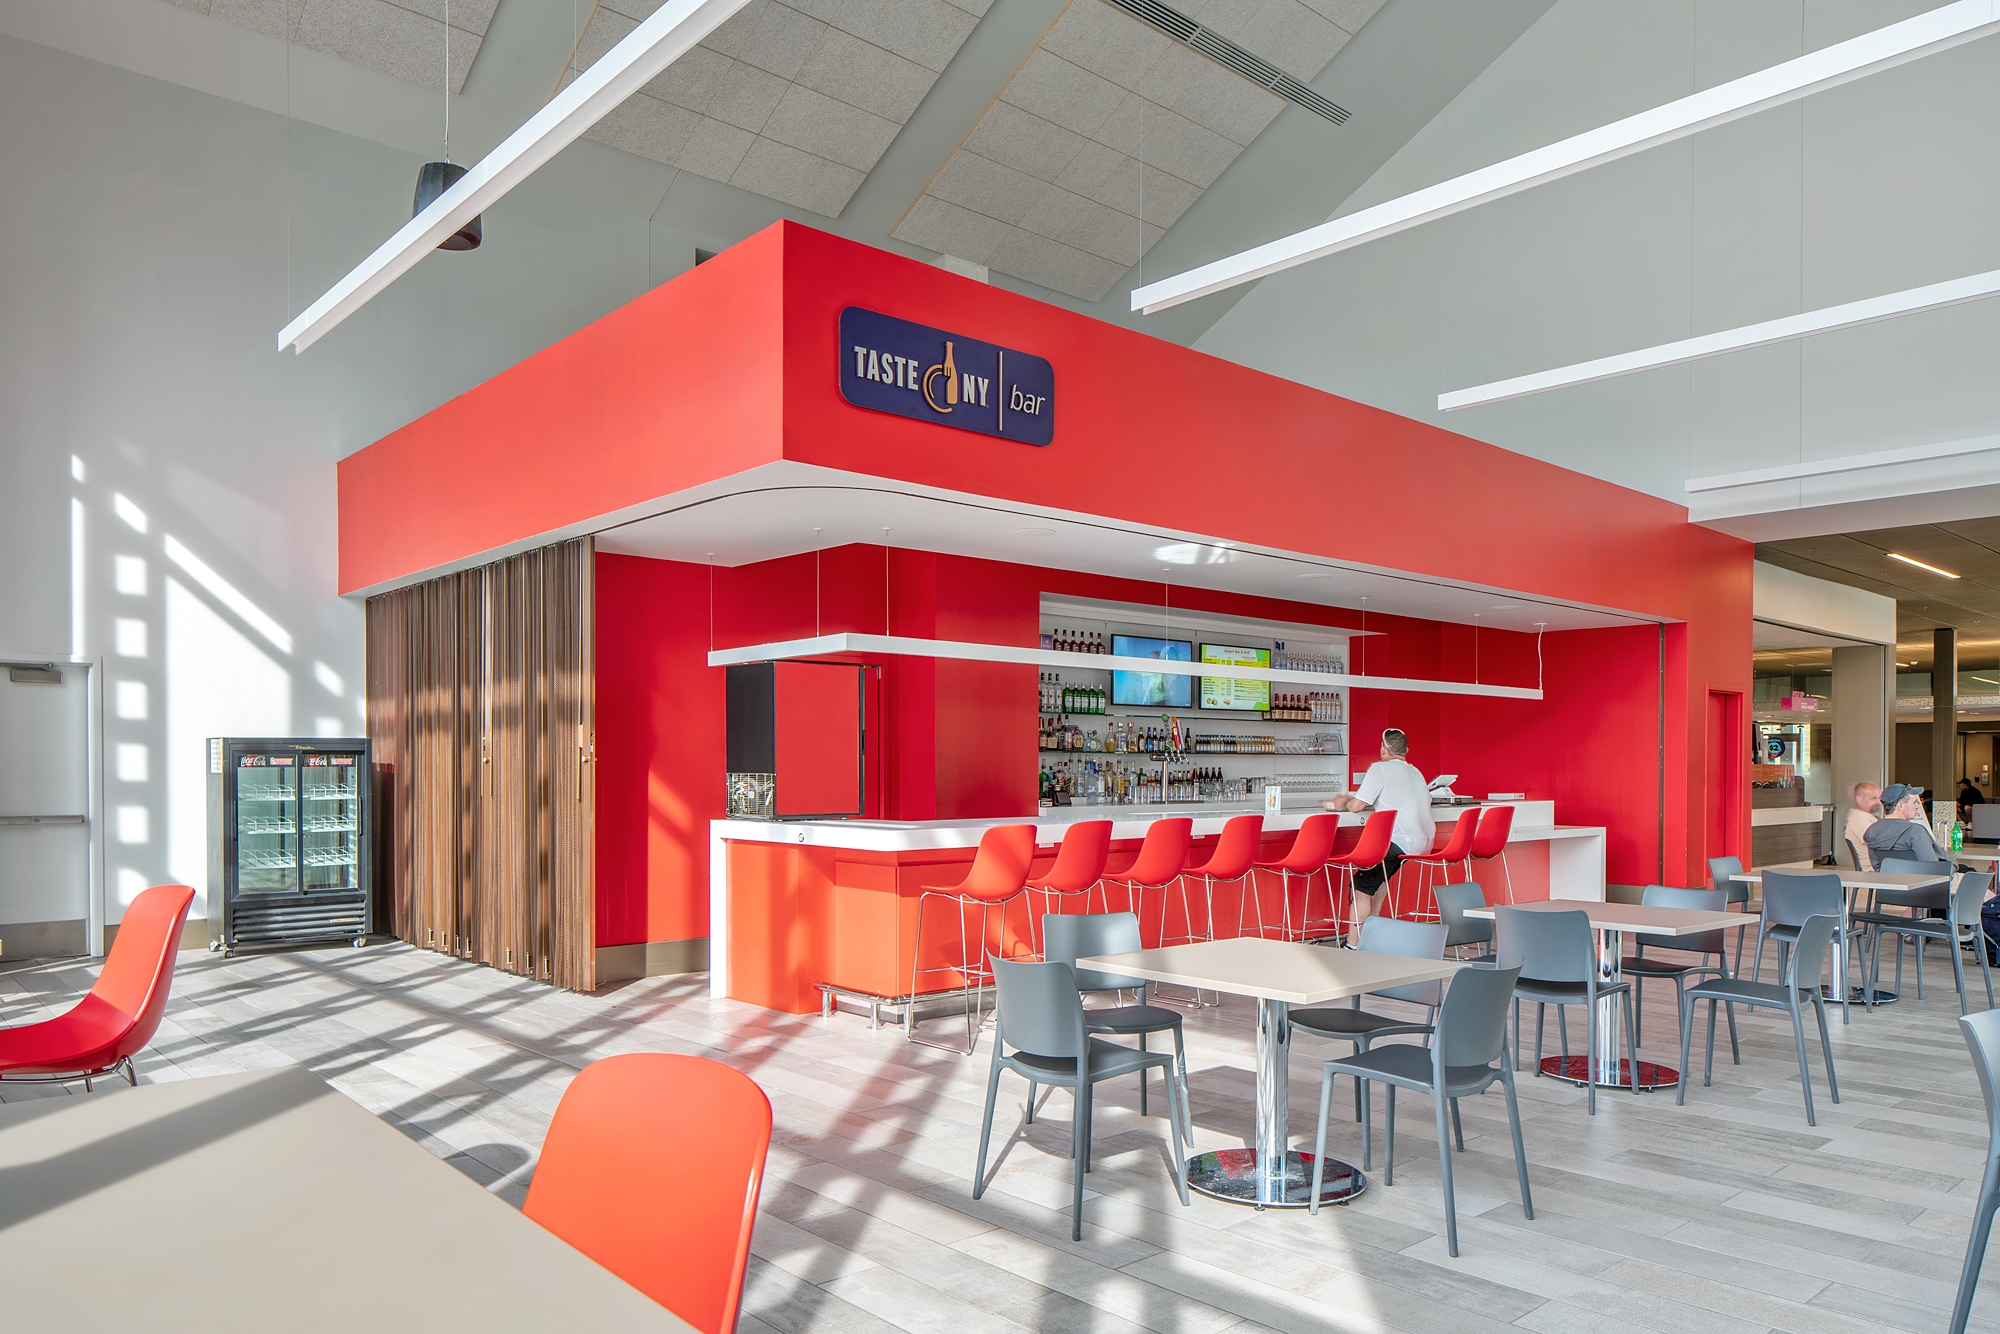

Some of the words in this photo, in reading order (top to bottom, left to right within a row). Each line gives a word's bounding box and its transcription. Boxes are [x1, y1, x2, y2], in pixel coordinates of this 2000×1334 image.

[853, 345, 919, 391] TASTE
[963, 373, 989, 407] NY
[1010, 384, 1046, 415] bar
